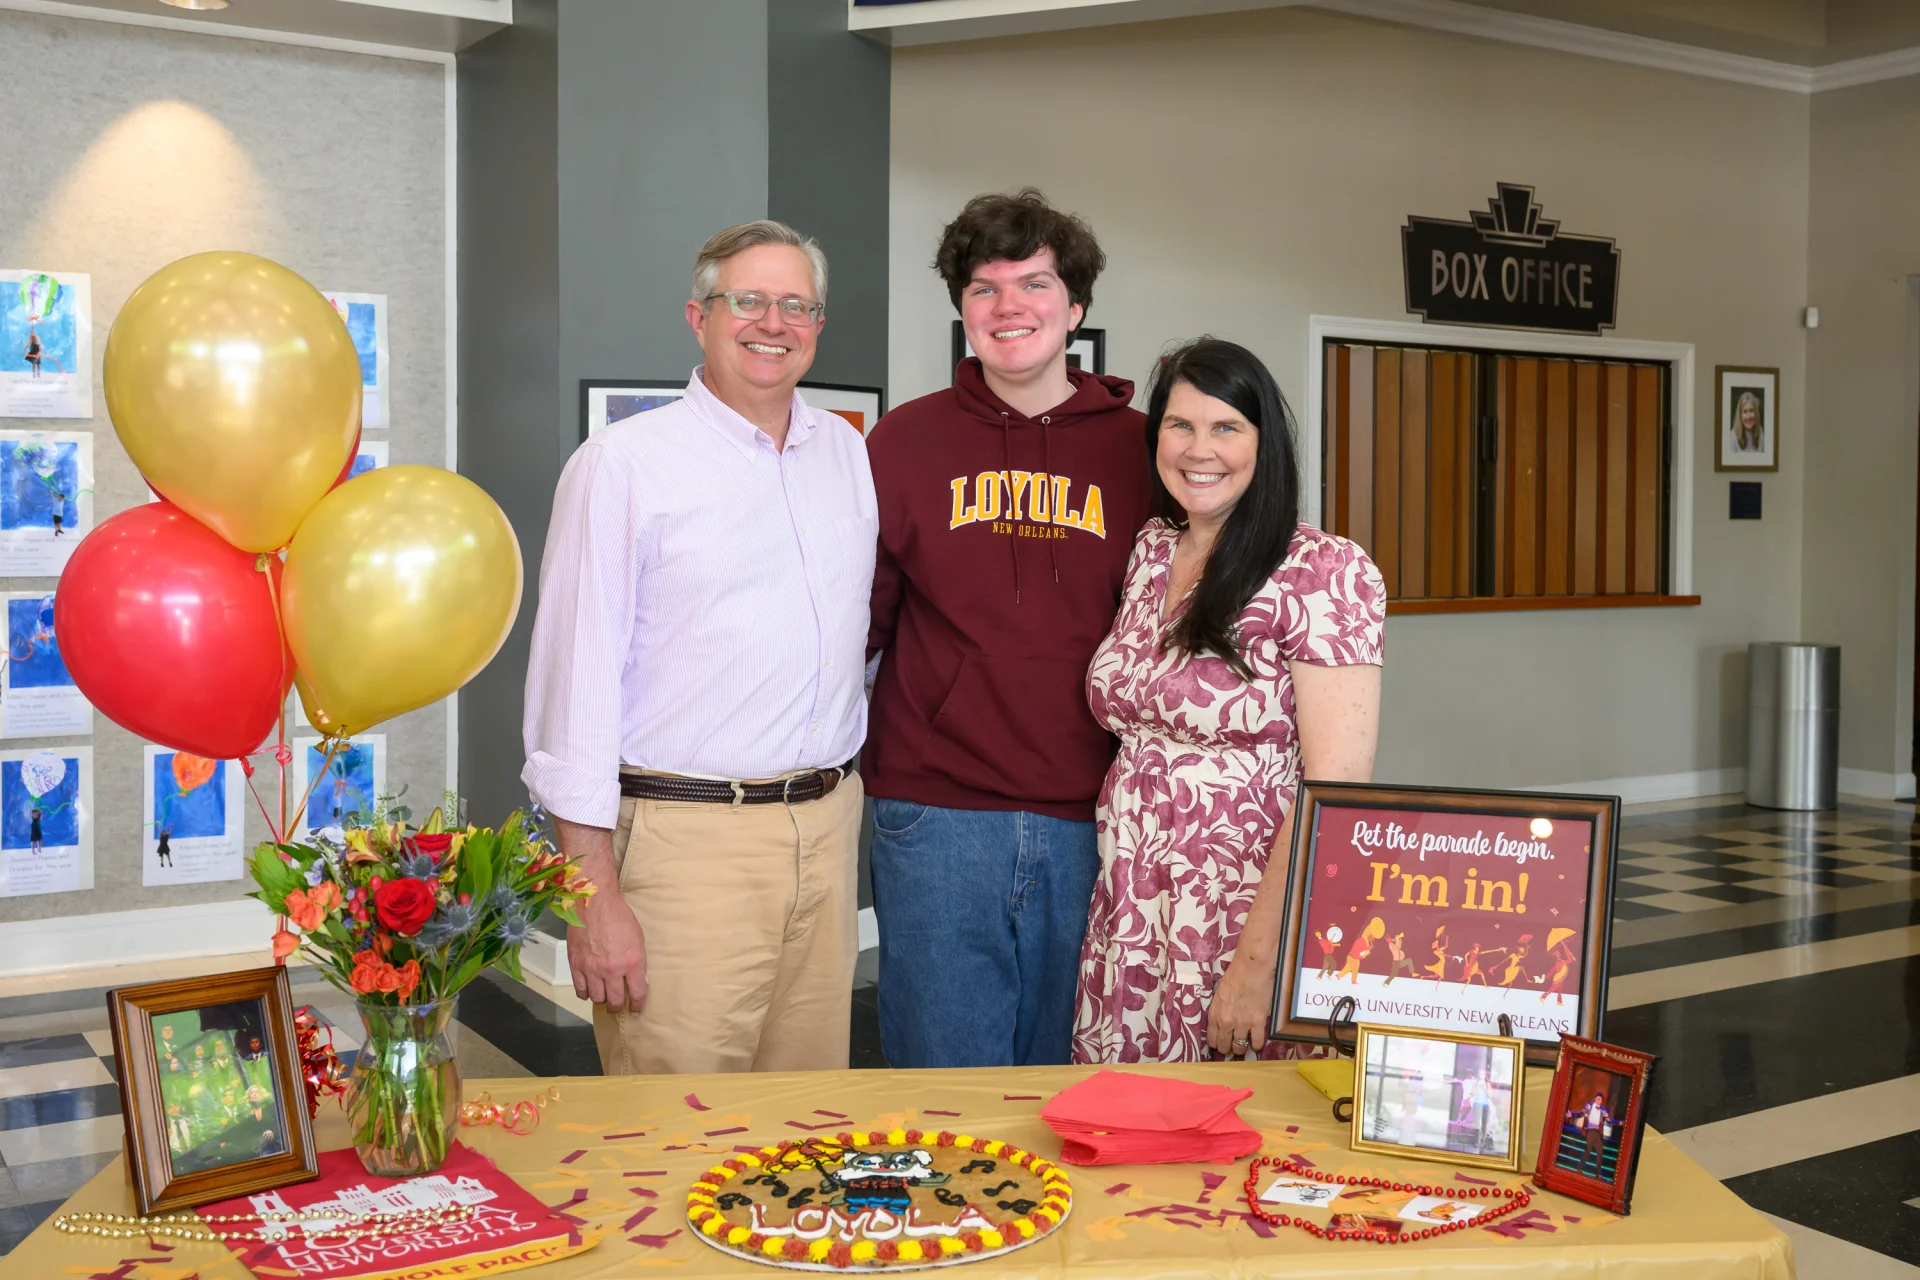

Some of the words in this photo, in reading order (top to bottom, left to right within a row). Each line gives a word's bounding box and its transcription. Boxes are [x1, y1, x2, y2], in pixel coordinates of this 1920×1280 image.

[1431, 248, 1489, 301] BOX
[1501, 256, 1593, 310] OFFICE
[949, 469, 1107, 540] LOYOLA
[992, 521, 1013, 535] NEW
[1350, 820, 1384, 857] Let
[1385, 821, 1420, 851] the
[1419, 829, 1492, 862] parade
[1493, 831, 1555, 865] begin.
[1366, 861, 1450, 908] I'm
[1461, 867, 1530, 914] in!
[1367, 999, 1453, 1020] UNIVERSITY
[1458, 1008, 1494, 1025] NEW
[1509, 1014, 1569, 1033] RLEANS
[284, 1211, 518, 1269] UNIVERSITY
[749, 1202, 998, 1242] LOYOLA
[295, 1251, 375, 1277] NEW
